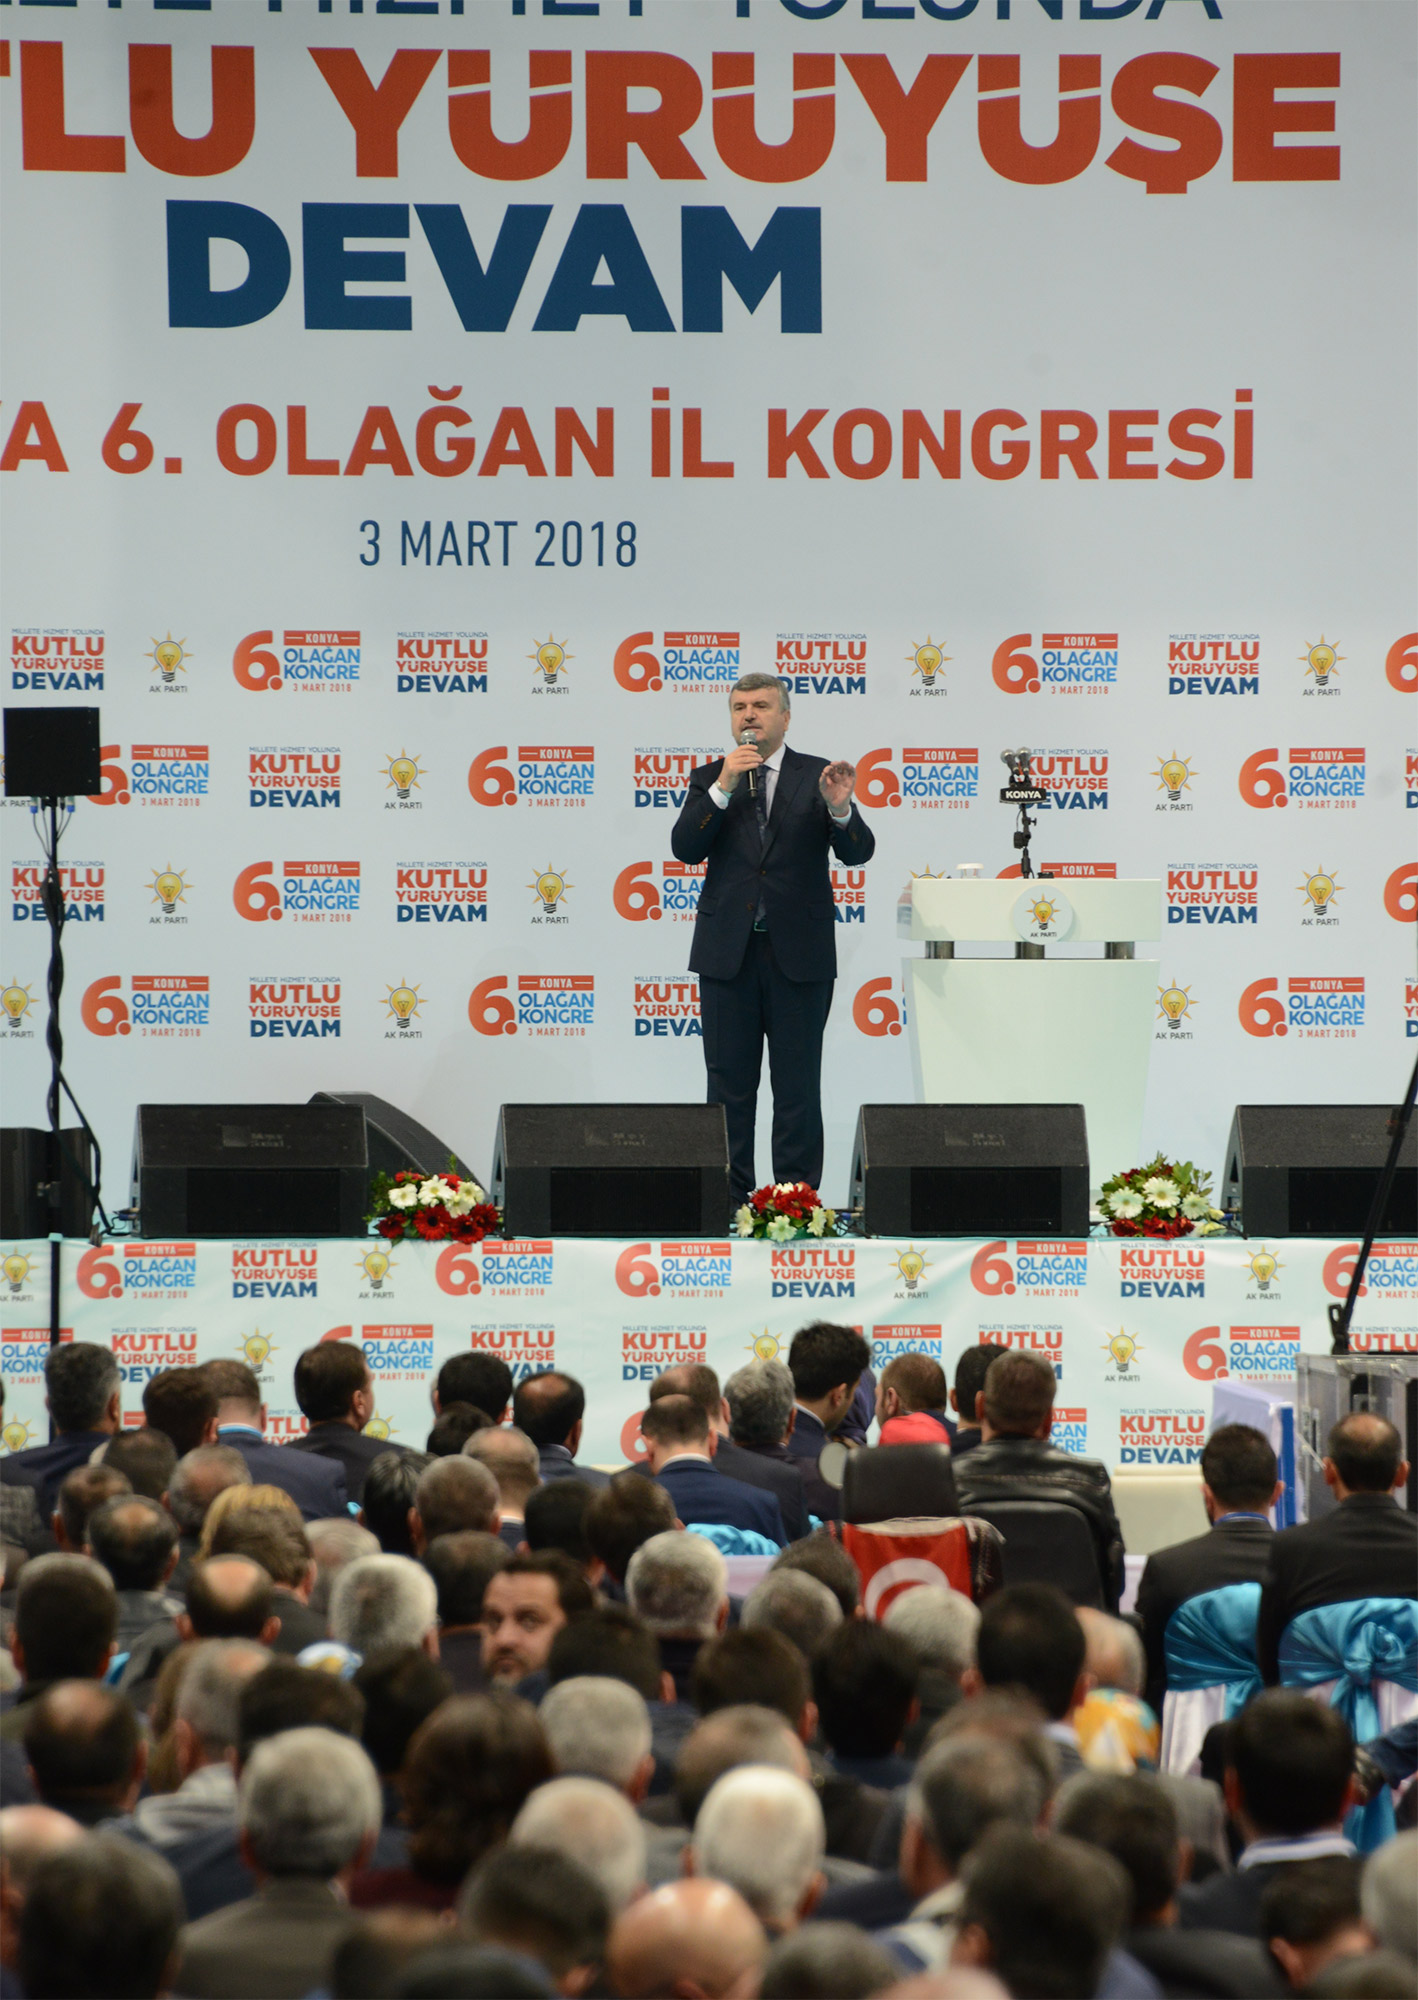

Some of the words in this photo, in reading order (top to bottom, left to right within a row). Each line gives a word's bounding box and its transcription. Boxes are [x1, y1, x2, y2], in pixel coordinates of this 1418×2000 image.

[0, 40, 256, 178] LU
[166, 199, 823, 335] DEVAM
[101, 402, 183, 475] 6.
[216, 385, 615, 478] OLAĞAN
[651, 387, 735, 479] İL
[768, 388, 1254, 481] KONGRESİ
[359, 520, 381, 567] 3
[400, 520, 518, 567] MART
[533, 520, 637, 568] 2018
[13, 636, 104, 656] KUTLU
[305, 633, 340, 643] KONYA
[685, 635, 719, 645] KONYA
[1063, 636, 1097, 646] KONYA
[284, 646, 361, 663] OLAĞAN
[398, 639, 488, 659] KUTLU
[663, 647, 740, 664] OLAĞAN
[777, 641, 866, 661] KUTLU
[1042, 649, 1118, 666] OLAĞAN
[1169, 641, 1259, 661] KUTLU
[12, 672, 104, 690] DEVAM
[284, 665, 360, 680] KONGRE
[664, 666, 739, 680] KONGRE
[1042, 667, 1117, 682] KONGRE
[293, 683, 298, 692] 3
[302, 683, 326, 692] MART
[330, 684, 352, 692] 2018
[398, 675, 488, 693] DEVAM
[673, 684, 678, 693] 3
[682, 684, 705, 693] MART
[709, 684, 731, 693] 2018
[1051, 686, 1056, 695] 3
[1060, 686, 1083, 695] MART
[1088, 686, 1109, 695] 2018
[1169, 677, 1259, 695] DEVAM
[153, 748, 188, 758] KONYA
[540, 749, 574, 759] KONYA
[924, 751, 958, 761] KONYA
[1310, 751, 1344, 761] KONYA
[132, 761, 209, 778] OLAĞAN
[251, 754, 341, 774] KUTLU
[518, 762, 594, 779] OLAĞAN
[903, 763, 978, 780] OLAĞAN
[1289, 763, 1365, 780] OLAĞAN
[132, 779, 208, 794] KONGRE
[519, 780, 594, 795] KONGRE
[903, 781, 978, 796] KONGRE
[1005, 790, 1042, 799] KONYA
[1289, 782, 1365, 796] KONGRE
[250, 790, 340, 808] DEVAM
[635, 790, 687, 807] DEV
[305, 864, 340, 874] KONYA
[1062, 865, 1095, 875] KONYA
[284, 877, 361, 894] OLAĞAN
[397, 869, 487, 889] KUTLU
[1168, 871, 1257, 890] KUTLU
[284, 895, 360, 910] KONGRE
[13, 903, 104, 921] DEAM
[397, 904, 487, 922] DEVAM
[1168, 906, 1257, 924] DEVAM
[154, 978, 188, 988] KONYA
[539, 978, 573, 988] KONYA
[1310, 980, 1344, 990] KONYA
[132, 991, 209, 1008] OLAĞAN
[251, 984, 341, 1004] KUTLU
[518, 991, 594, 1008] OLAĞAN
[635, 984, 701, 1003] KUTL
[1288, 993, 1365, 1010] OLAĞAN
[132, 1010, 209, 1025] KONGRE
[518, 1009, 594, 1024] KONGRE
[1289, 1011, 1364, 1026] KONGRE
[251, 1019, 341, 1037] DEVAM
[635, 1018, 703, 1036] DEVA
[232, 1249, 317, 1267] KUTLU
[771, 1249, 855, 1267] KUTLU
[1120, 1249, 1204, 1267] KUTLU
[125, 1274, 196, 1288] KONGRE
[483, 1271, 553, 1285] KONGRE
[662, 1273, 732, 1287] KONGRE
[1017, 1272, 1087, 1285] KONGRE
[232, 1282, 317, 1298] DEVAM
[771, 1282, 855, 1298] DEVAM
[1120, 1282, 1204, 1298] DEVAM
[471, 1331, 554, 1349] KUTLU
[892, 1327, 922, 1336] KONYA
[112, 1334, 197, 1352] KUTLU
[623, 1332, 706, 1350] KUTLU
[1120, 1415, 1204, 1434] KUTLU
